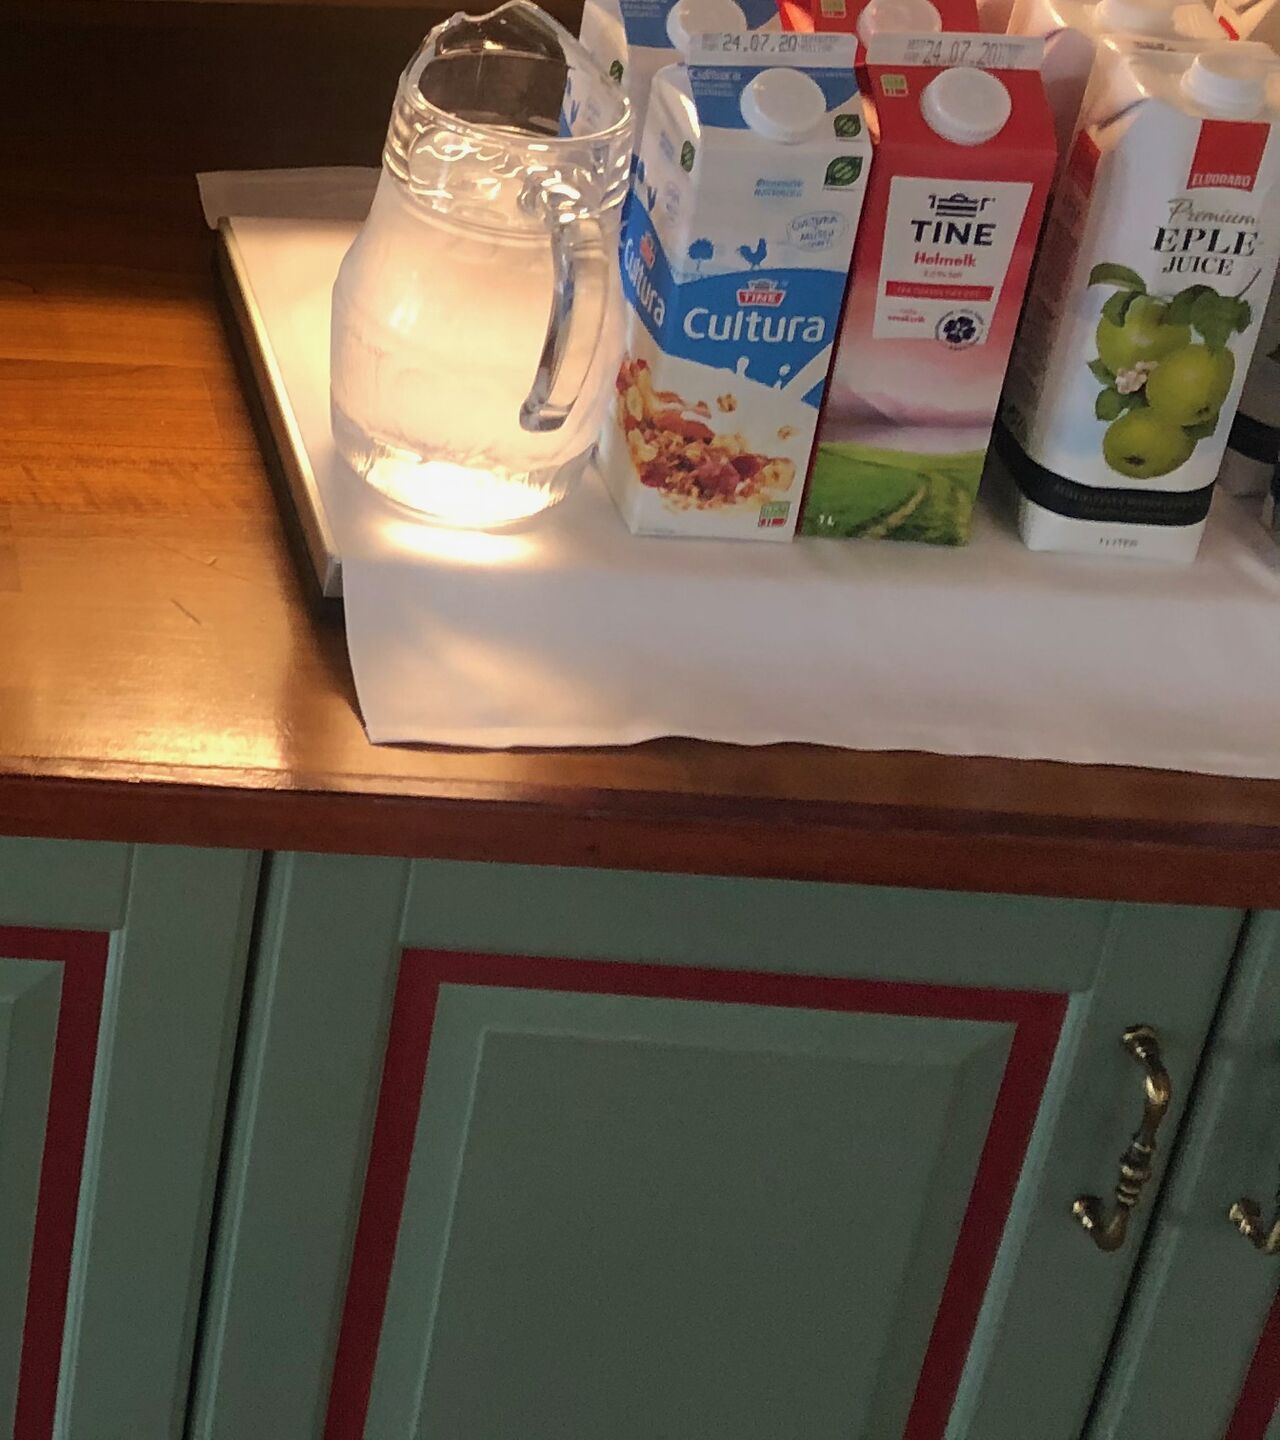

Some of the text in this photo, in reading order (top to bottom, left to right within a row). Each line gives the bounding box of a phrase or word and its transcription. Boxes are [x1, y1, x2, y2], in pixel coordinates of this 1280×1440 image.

[721, 33, 798, 53] 24.07.20
[1191, 172, 1252, 188] ELDORADO
[911, 219, 997, 247] TINE
[1151, 225, 1259, 257] EPLE
[913, 251, 977, 268] Helmelk
[1161, 256, 1235, 277] JUICE
[682, 307, 826, 343] Cultura
